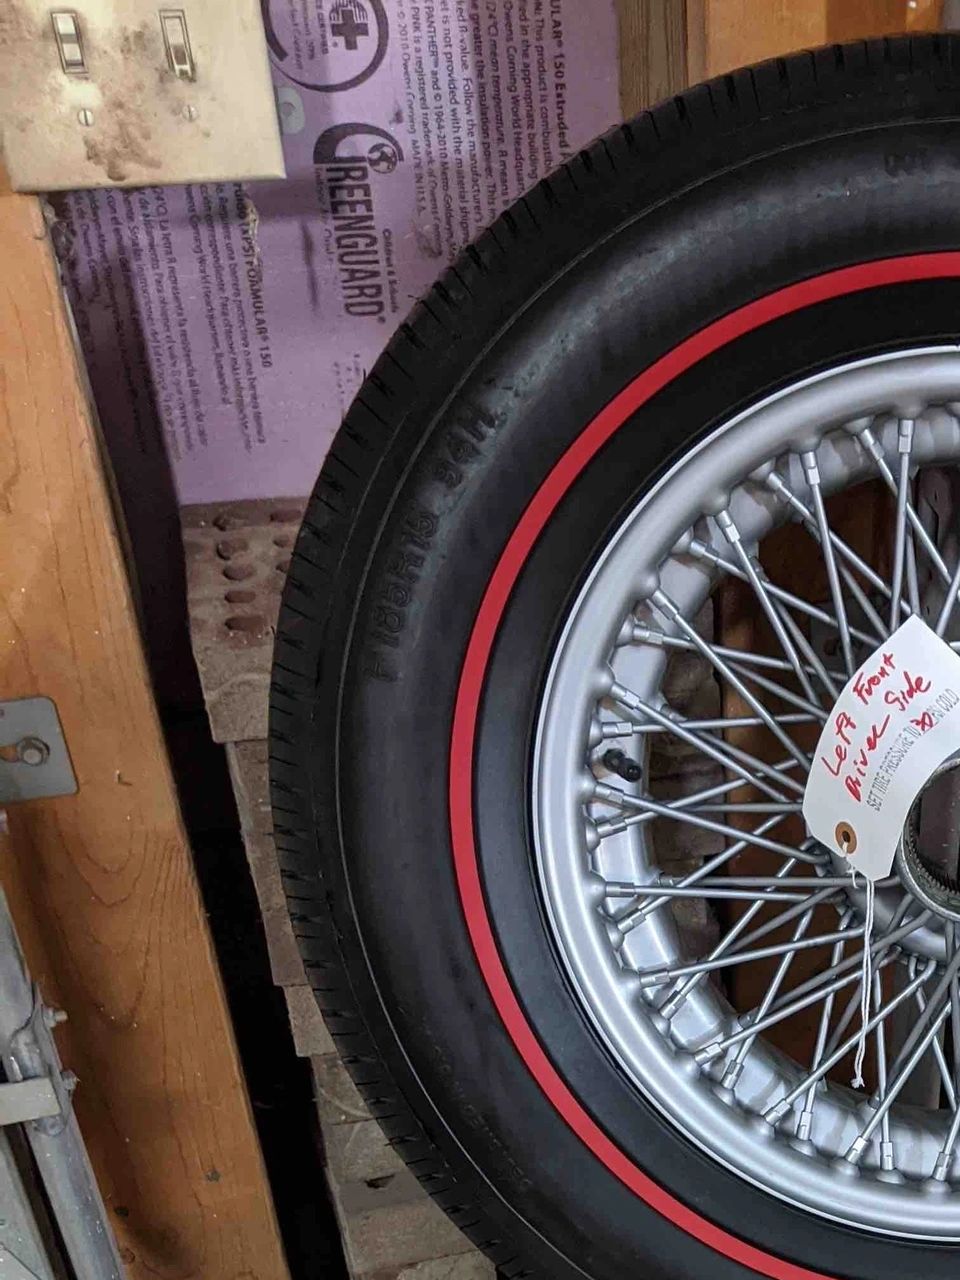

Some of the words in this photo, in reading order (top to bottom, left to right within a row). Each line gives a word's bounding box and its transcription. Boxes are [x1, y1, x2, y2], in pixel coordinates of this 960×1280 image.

[411, 6, 421, 33] PINK
[443, 28, 452, 48] not
[469, 13, 482, 56] greater
[521, 39, 531, 59] the
[534, 44, 546, 91] product
[553, 54, 565, 79] 150
[414, 56, 428, 109] registered
[431, 70, 441, 90] and
[443, 51, 458, 105] provided
[476, 59, 485, 79] the
[504, 45, 519, 92] Corning
[404, 93, 416, 134] Corning
[462, 78, 474, 114] Follow
[477, 82, 490, 138] insulation
[510, 95, 521, 128] World
[520, 61, 534, 130] appropriate
[450, 107, 461, 132] with
[555, 82, 570, 148] Extruded
[421, 111, 434, 164] trademark
[453, 136, 463, 154] the
[525, 132, 538, 180] building
[455, 157, 468, 203] material
[258, 345, 271, 369] 150
[884, 671, 933, 712] Side
[936, 688, 960, 712] COLD
[821, 711, 857, 777] Left
[852, 652, 895, 705] Front
[903, 726, 921, 739] TO
[880, 733, 914, 776] PRESSURE
[866, 790, 883, 811] SET
[872, 772, 890, 796] TIRE
